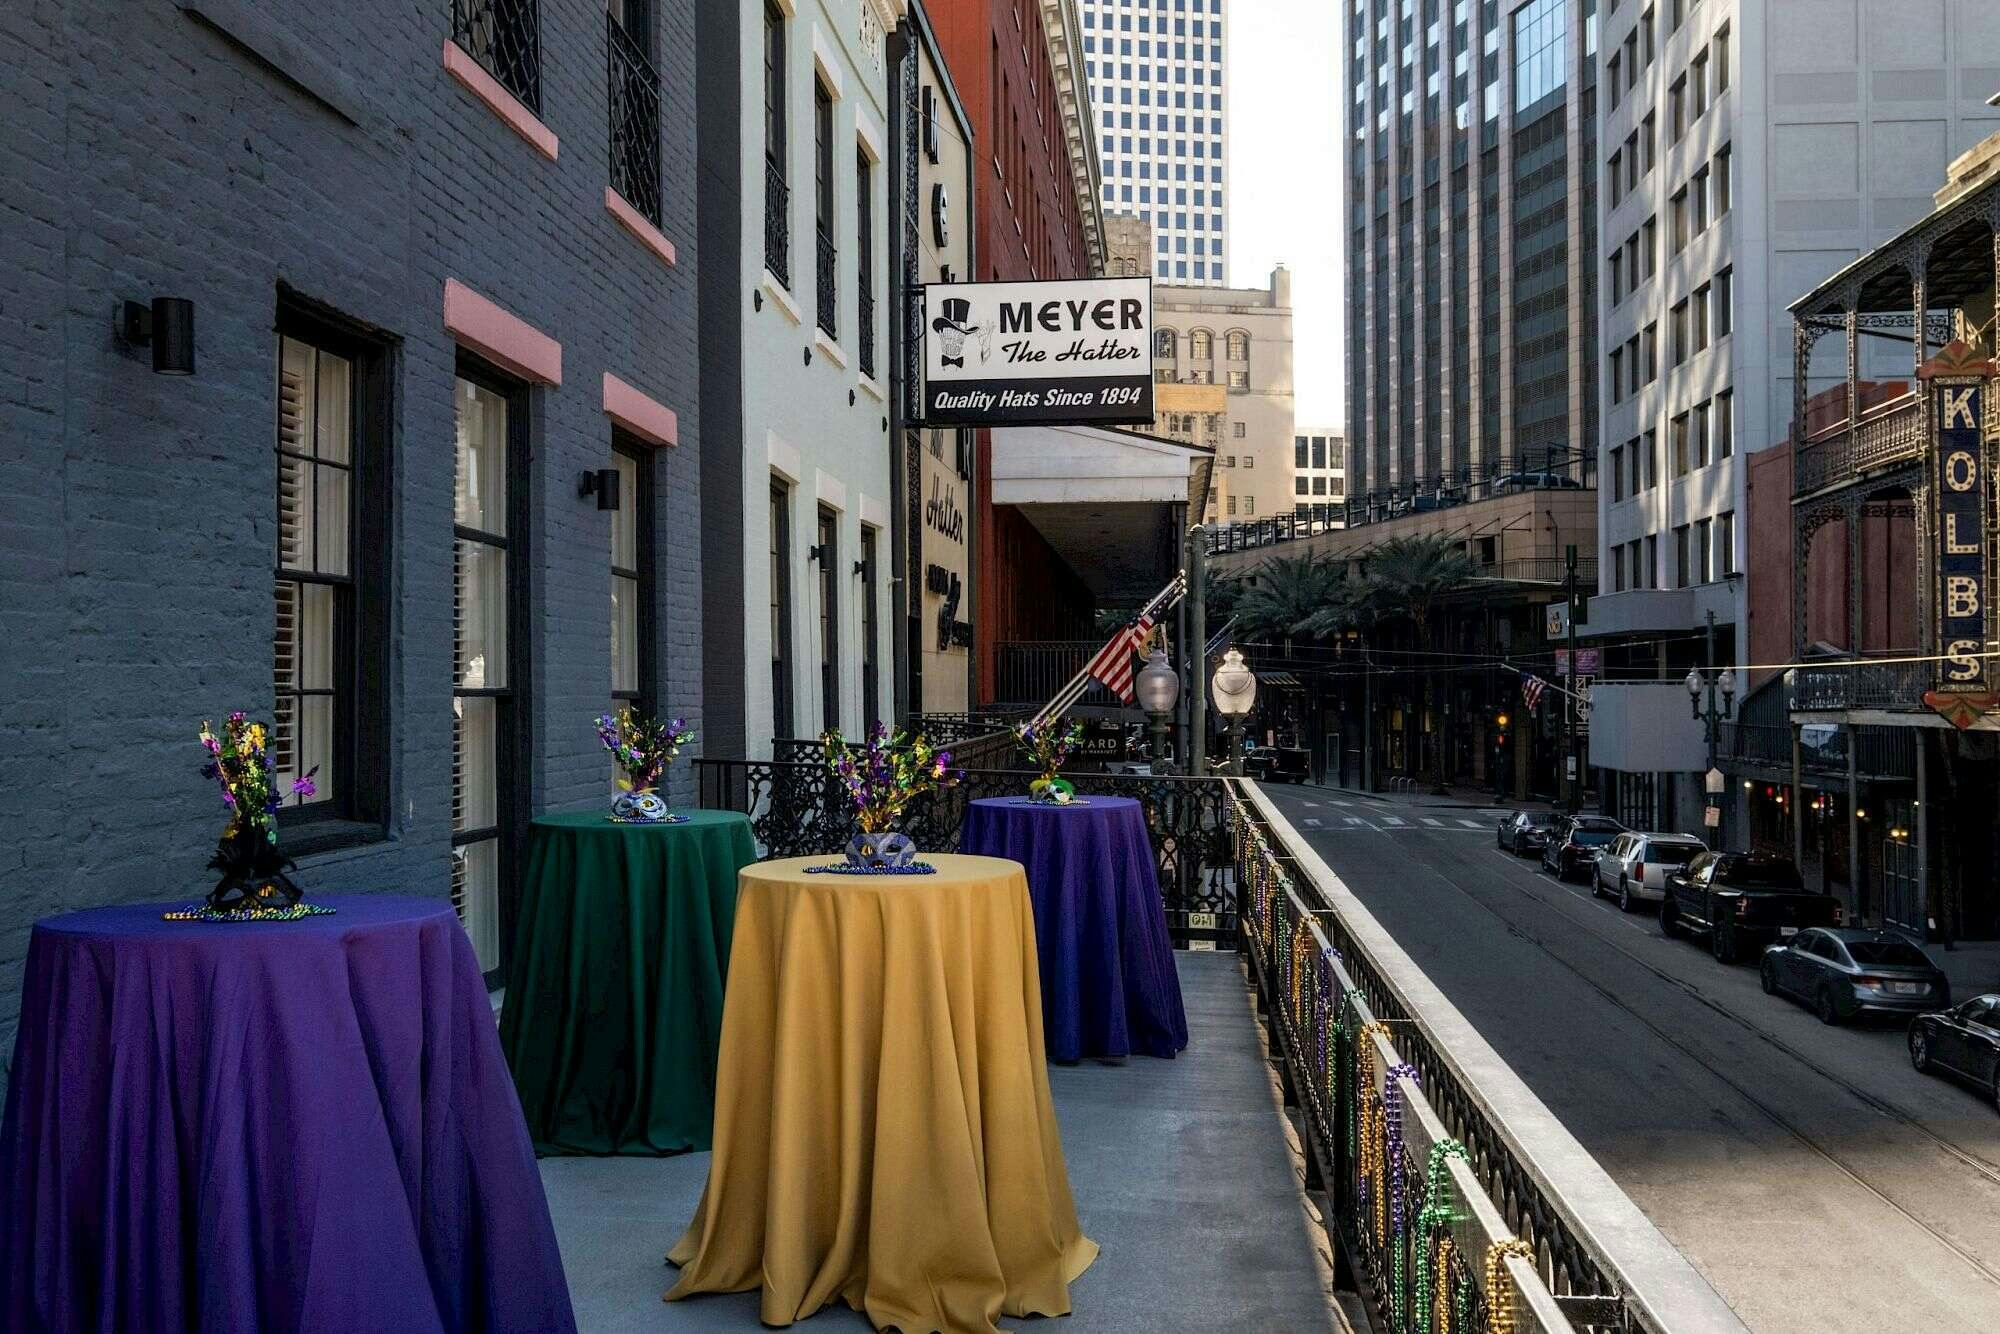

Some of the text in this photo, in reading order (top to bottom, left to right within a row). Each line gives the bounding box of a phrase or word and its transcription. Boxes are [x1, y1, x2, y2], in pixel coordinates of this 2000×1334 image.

[999, 299, 1144, 334] MEYER
[1002, 338, 1141, 364] The Hatter
[934, 386, 1143, 413] Quality Hats Since 1894
[926, 471, 963, 545] Hatter
[1942, 388, 1981, 681] KOLBS
